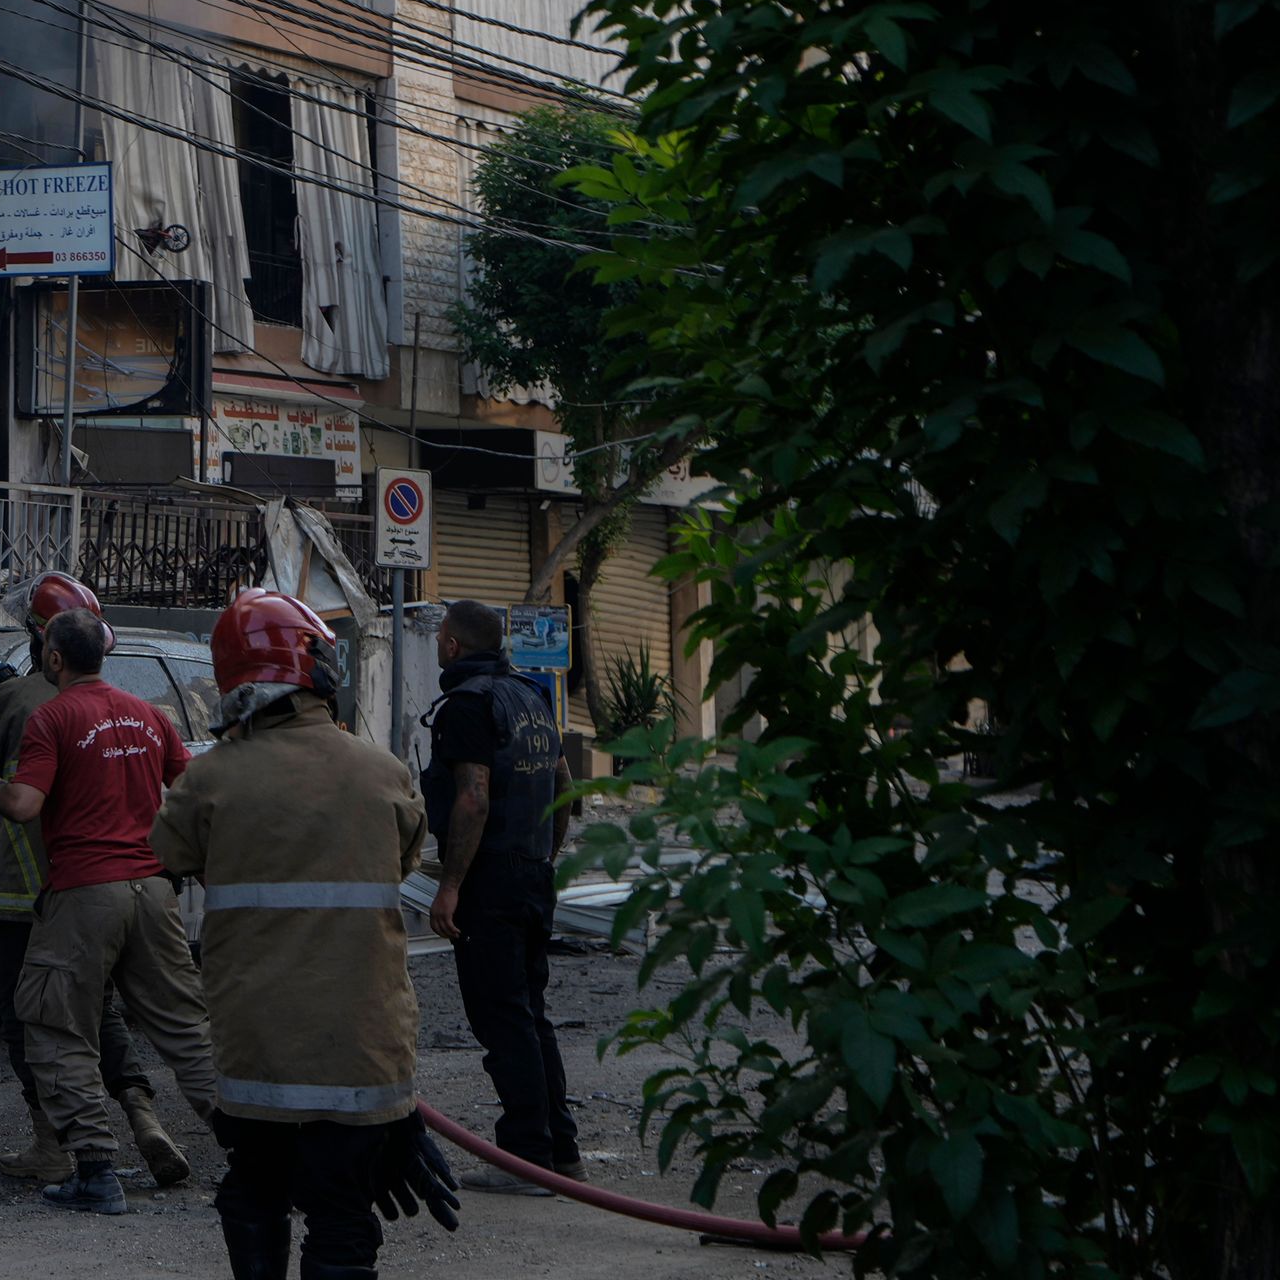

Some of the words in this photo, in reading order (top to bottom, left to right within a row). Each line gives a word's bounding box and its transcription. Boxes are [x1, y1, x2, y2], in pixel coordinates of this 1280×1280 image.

[3, 179, 38, 195] HOT
[44, 175, 107, 193] FREEZE
[55, 252, 67, 262] 03
[69, 251, 107, 262] 866350
[124, 744, 147, 756] مركز
[526, 734, 549, 754] 190
